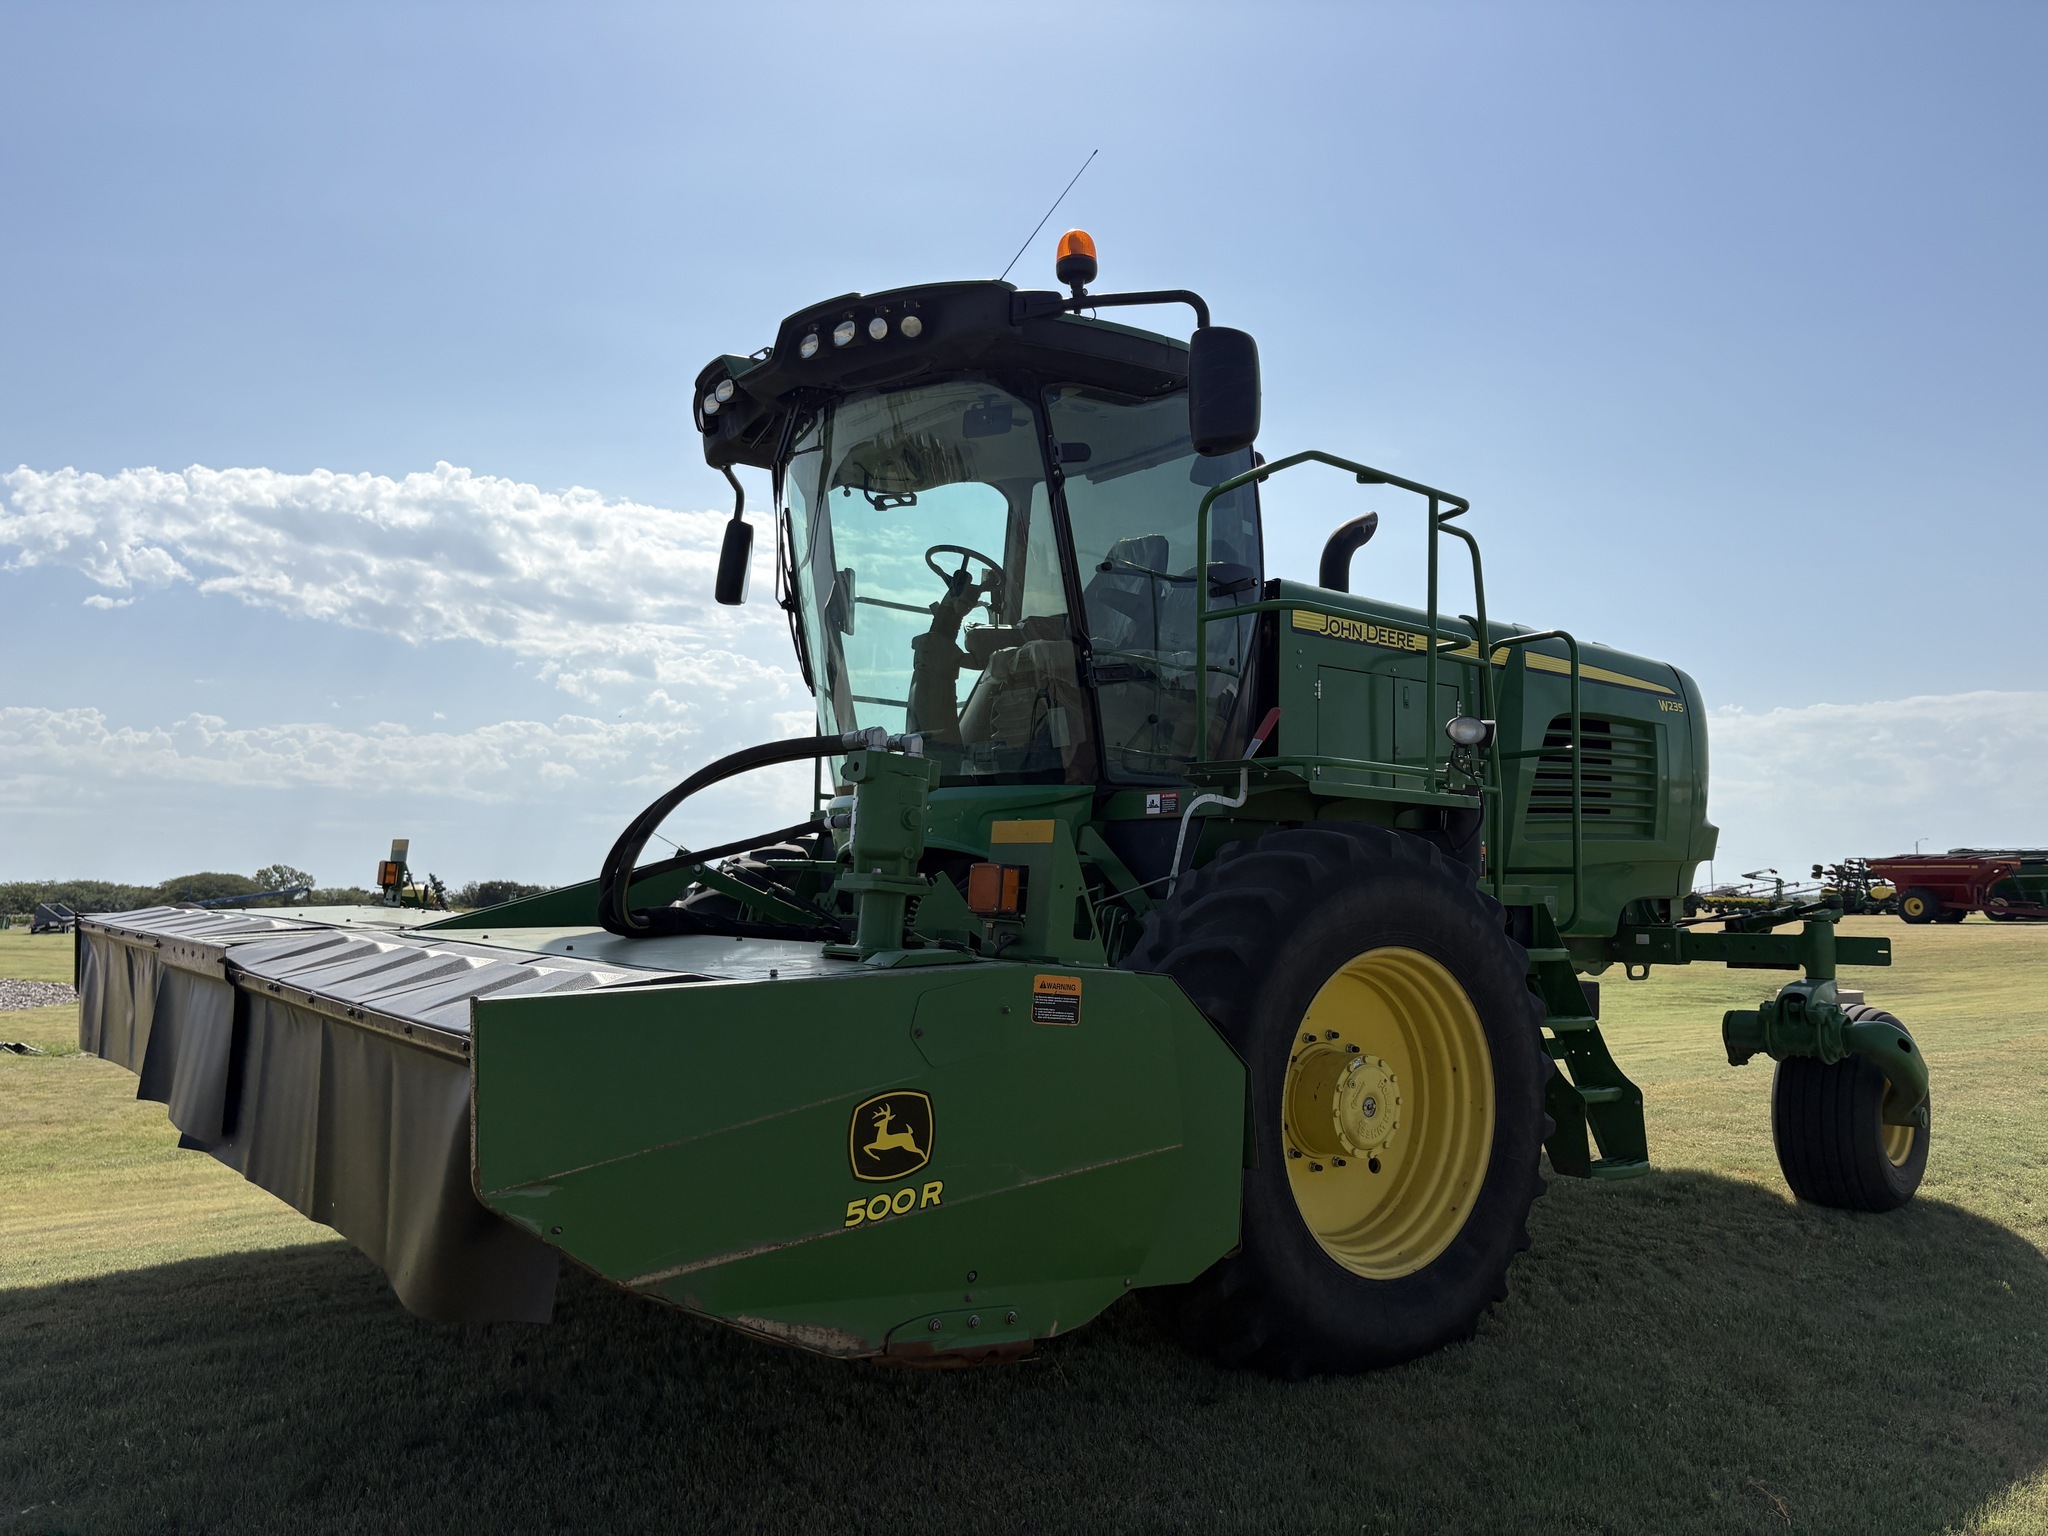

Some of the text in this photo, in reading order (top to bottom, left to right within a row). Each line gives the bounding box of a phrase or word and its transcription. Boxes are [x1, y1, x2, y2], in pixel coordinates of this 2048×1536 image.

[1319, 615, 1416, 649] JOHN DEERE
[1657, 699, 1684, 713] W235
[1046, 982, 1076, 991] WARNING
